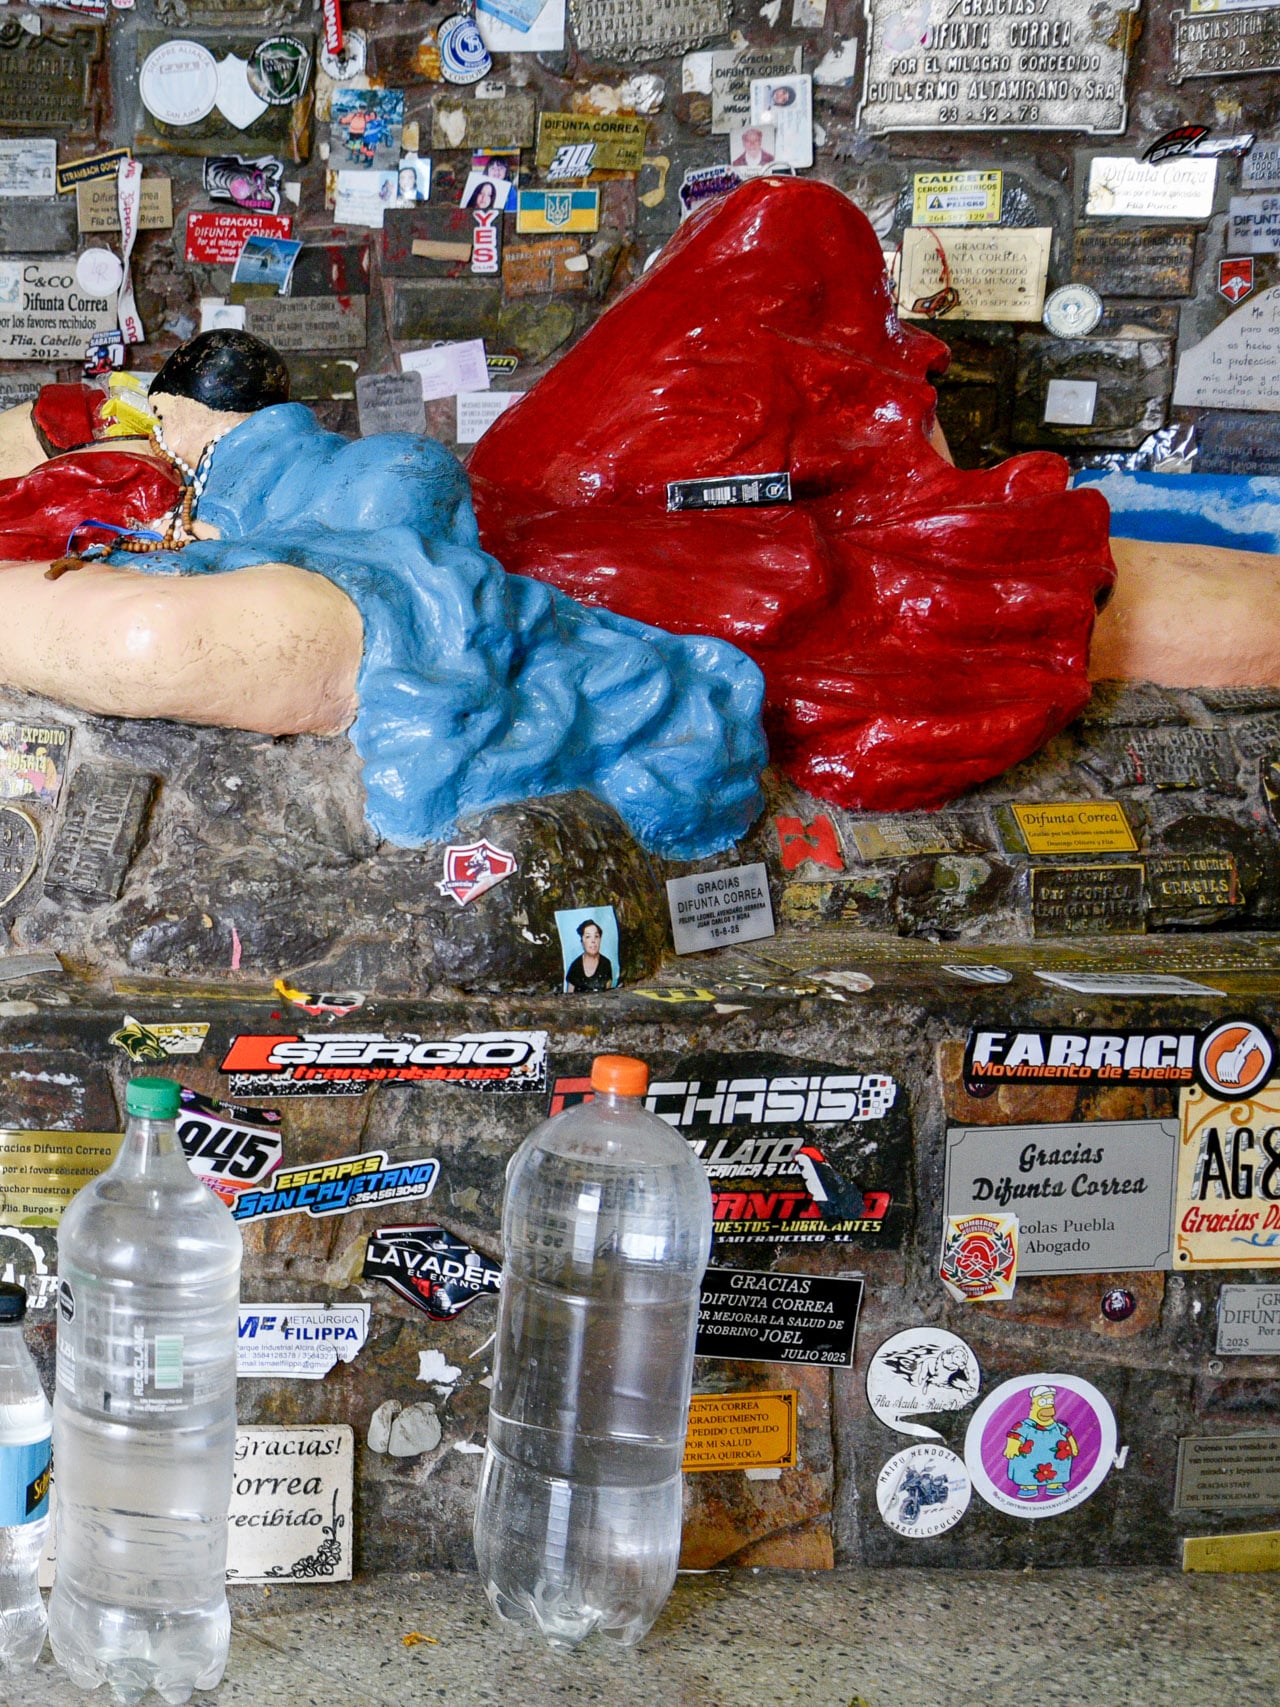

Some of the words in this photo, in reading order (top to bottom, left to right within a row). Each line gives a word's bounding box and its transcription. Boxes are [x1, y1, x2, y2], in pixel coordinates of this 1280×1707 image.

[1009, 21, 1071, 50] CORREA
[716, 66, 756, 78] DIFUNTA
[759, 64, 797, 76] CORREA
[891, 57, 917, 74] POR
[924, 57, 941, 73] EL
[947, 56, 1010, 73] MILAGRO
[1019, 55, 1101, 71] CONCEDIDO
[869, 80, 959, 101] GUILLERMO
[969, 79, 1069, 100] ALTAMIRANO
[939, 107, 958, 122] 23
[981, 106, 998, 121] 12
[1019, 106, 1040, 121] 78
[544, 119, 590, 132] DIFUNTA
[593, 121, 640, 134] CORREA
[62, 164, 100, 184] STRAMBACH
[918, 173, 998, 184] CAUCETE
[1103, 166, 1159, 185] Difunta
[1163, 166, 1208, 185] Correa
[917, 185, 949, 193] CERCOS
[946, 200, 985, 208] PELIGRO
[195, 226, 238, 238] DIFUNTA
[472, 209, 500, 264] YES
[69, 294, 109, 313] Correa
[12, 315, 26, 329] los
[27, 316, 57, 330] favores
[58, 316, 97, 330] recibidos
[9, 334, 37, 347] Flia.
[40, 334, 83, 347] Cabello
[31, 348, 60, 358] 2012
[21, 727, 66, 746] EXPEDITO
[1023, 812, 1075, 828] Difunta
[1078, 813, 1119, 823] Correa
[697, 876, 740, 895] GRACIAS
[677, 897, 721, 914] DIFUNTA
[723, 888, 765, 906] CORREA
[268, 1041, 531, 1065] SERGIO
[973, 1032, 1196, 1070] FABRICI
[292, 1066, 512, 1081] transmisiones
[971, 1060, 1092, 1078] Movimiento
[1098, 1063, 1122, 1079] de
[1128, 1065, 1194, 1080] suelos
[644, 1074, 865, 1125] CHASIS
[33, 1144, 72, 1156] Difunta
[76, 1145, 112, 1156] Correa
[1019, 1142, 1105, 1173] Gracias
[276, 1156, 384, 1190] ESCAPES
[972, 1175, 1067, 1206] Difunta
[1071, 1174, 1148, 1198] Correa
[21, 1204, 56, 1216] Burgos
[1063, 1217, 1116, 1232] Puebla
[1180, 1206, 1260, 1235] Gracias
[1025, 1239, 1091, 1256] Abogado
[407, 1268, 422, 1278] EL
[430, 1271, 481, 1291] ENANO
[729, 1274, 812, 1294] GRACIAS
[700, 1292, 769, 1309] DIFUNTA
[772, 1298, 836, 1314] CORREA
[712, 1311, 768, 1324] MEJORAR
[769, 1315, 785, 1326] LA
[786, 1317, 826, 1329] SALUD
[827, 1319, 845, 1330] DE
[284, 1327, 359, 1341] FILIPPA
[706, 1324, 759, 1338] SOBRINO
[759, 1328, 804, 1345] JOEL
[1226, 1338, 1249, 1347] 2025
[133, 1326, 145, 1397] RECICLAME
[781, 1348, 820, 1361] JULIO
[821, 1351, 847, 1363] 2025
[720, 1402, 760, 1412] CORREA
[692, 1427, 728, 1436] PEDIDO
[729, 1425, 780, 1434] CUMPLIDO
[705, 1439, 719, 1448] MI
[720, 1438, 752, 1448] SALUD
[718, 1450, 762, 1461] QUIROGA
[911, 1448, 958, 1463] MENDOZA
